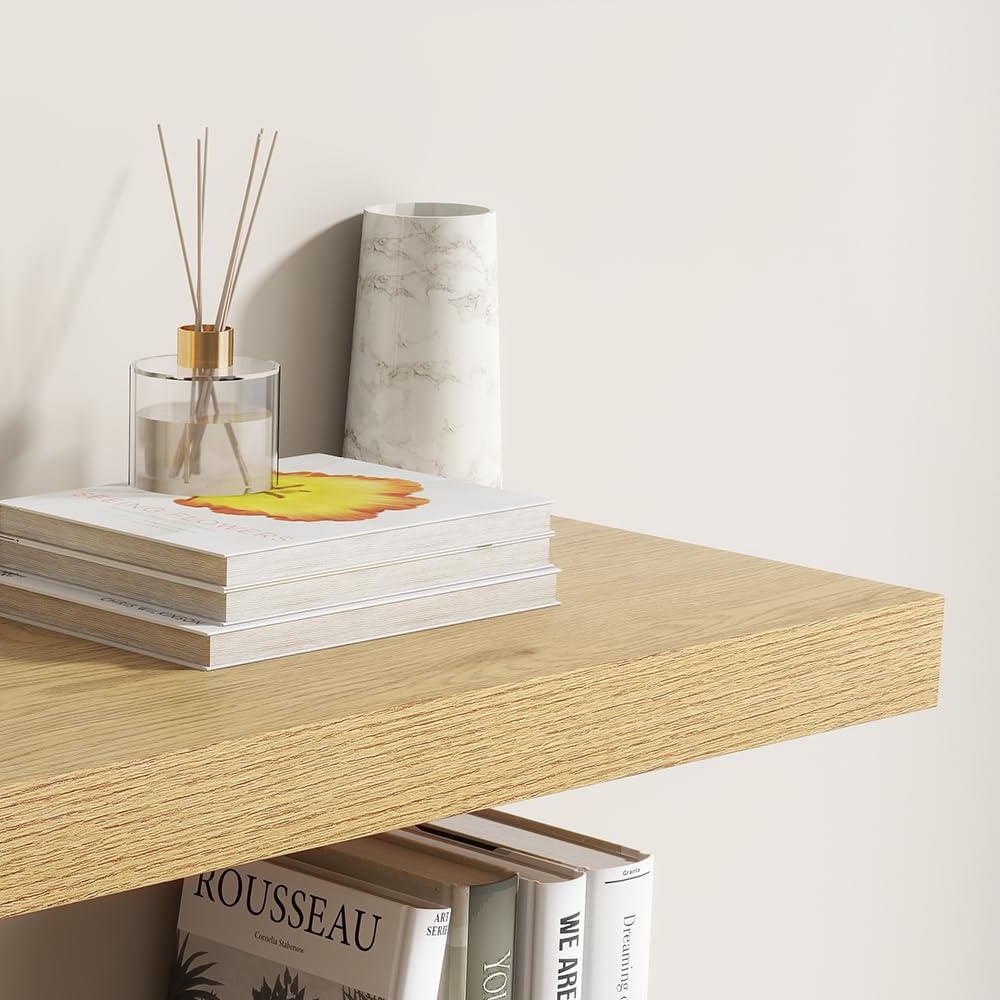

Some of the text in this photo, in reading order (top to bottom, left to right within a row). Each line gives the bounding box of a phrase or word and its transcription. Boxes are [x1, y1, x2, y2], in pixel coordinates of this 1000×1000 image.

[194, 868, 382, 951] ROUSSEAU
[254, 931, 278, 946] Cornelia
[559, 911, 580, 951] WE
[616, 914, 636, 993] Dreaming
